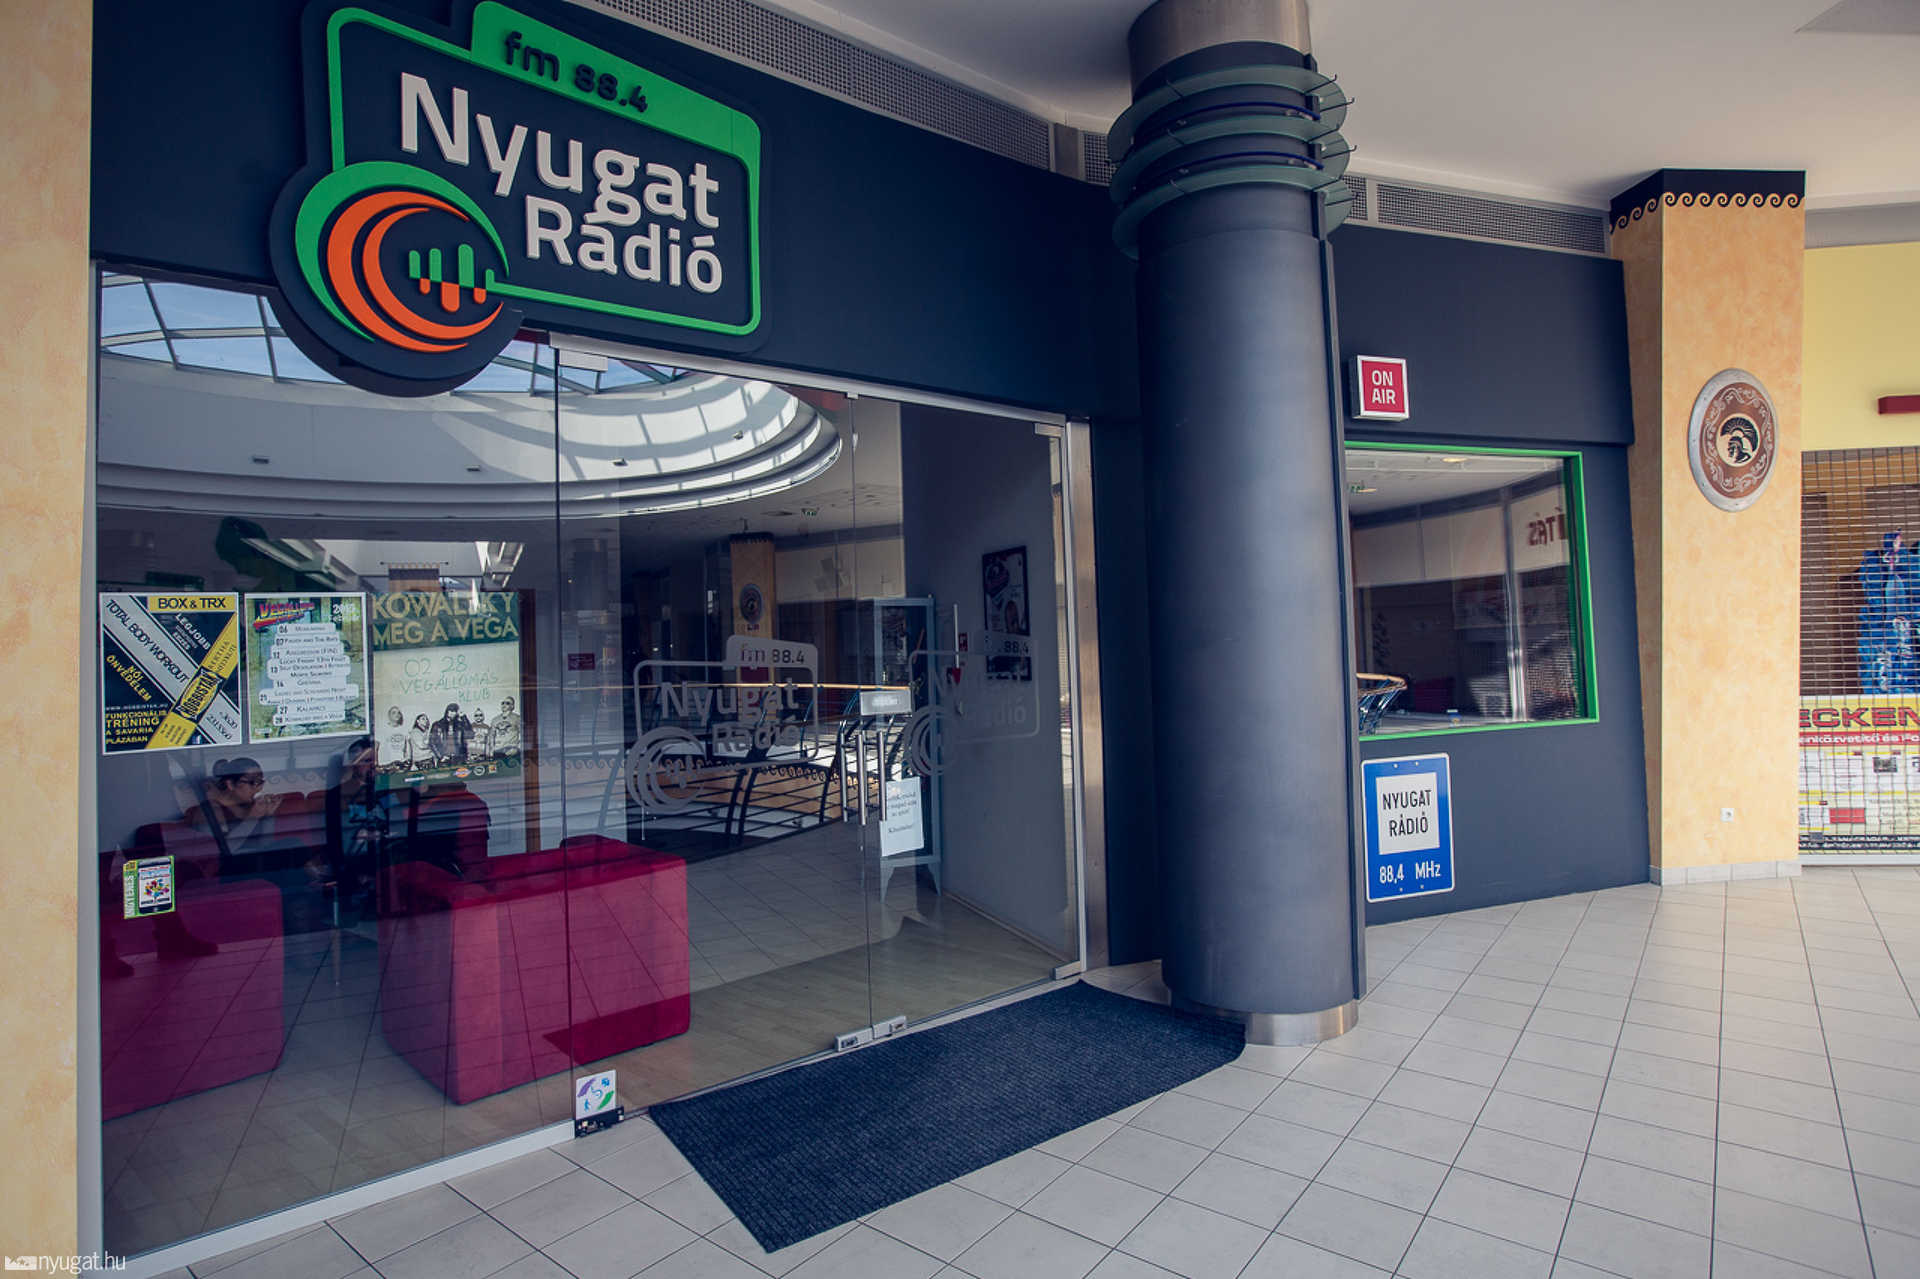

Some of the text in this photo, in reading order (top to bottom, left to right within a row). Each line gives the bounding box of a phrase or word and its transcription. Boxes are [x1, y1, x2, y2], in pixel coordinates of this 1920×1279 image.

[503, 30, 649, 114] fm 88.4
[400, 71, 721, 228] Nyugat
[525, 194, 723, 294] Radió
[1371, 369, 1393, 387] ON
[1371, 387, 1396, 405] AIR
[158, 597, 226, 609] BOX & TRX
[105, 598, 131, 627] TOTAL
[128, 622, 153, 647] BODY
[149, 641, 190, 683] WORKOUT
[372, 616, 519, 646] MEG A VEGA
[440, 654, 468, 674] 28
[771, 648, 806, 665] 88.4
[659, 677, 800, 729] Nyugat
[1382, 789, 1432, 810] NYUGAT
[1389, 811, 1429, 837] RÁDIÓ
[1379, 860, 1442, 884] 88,4 MHz
